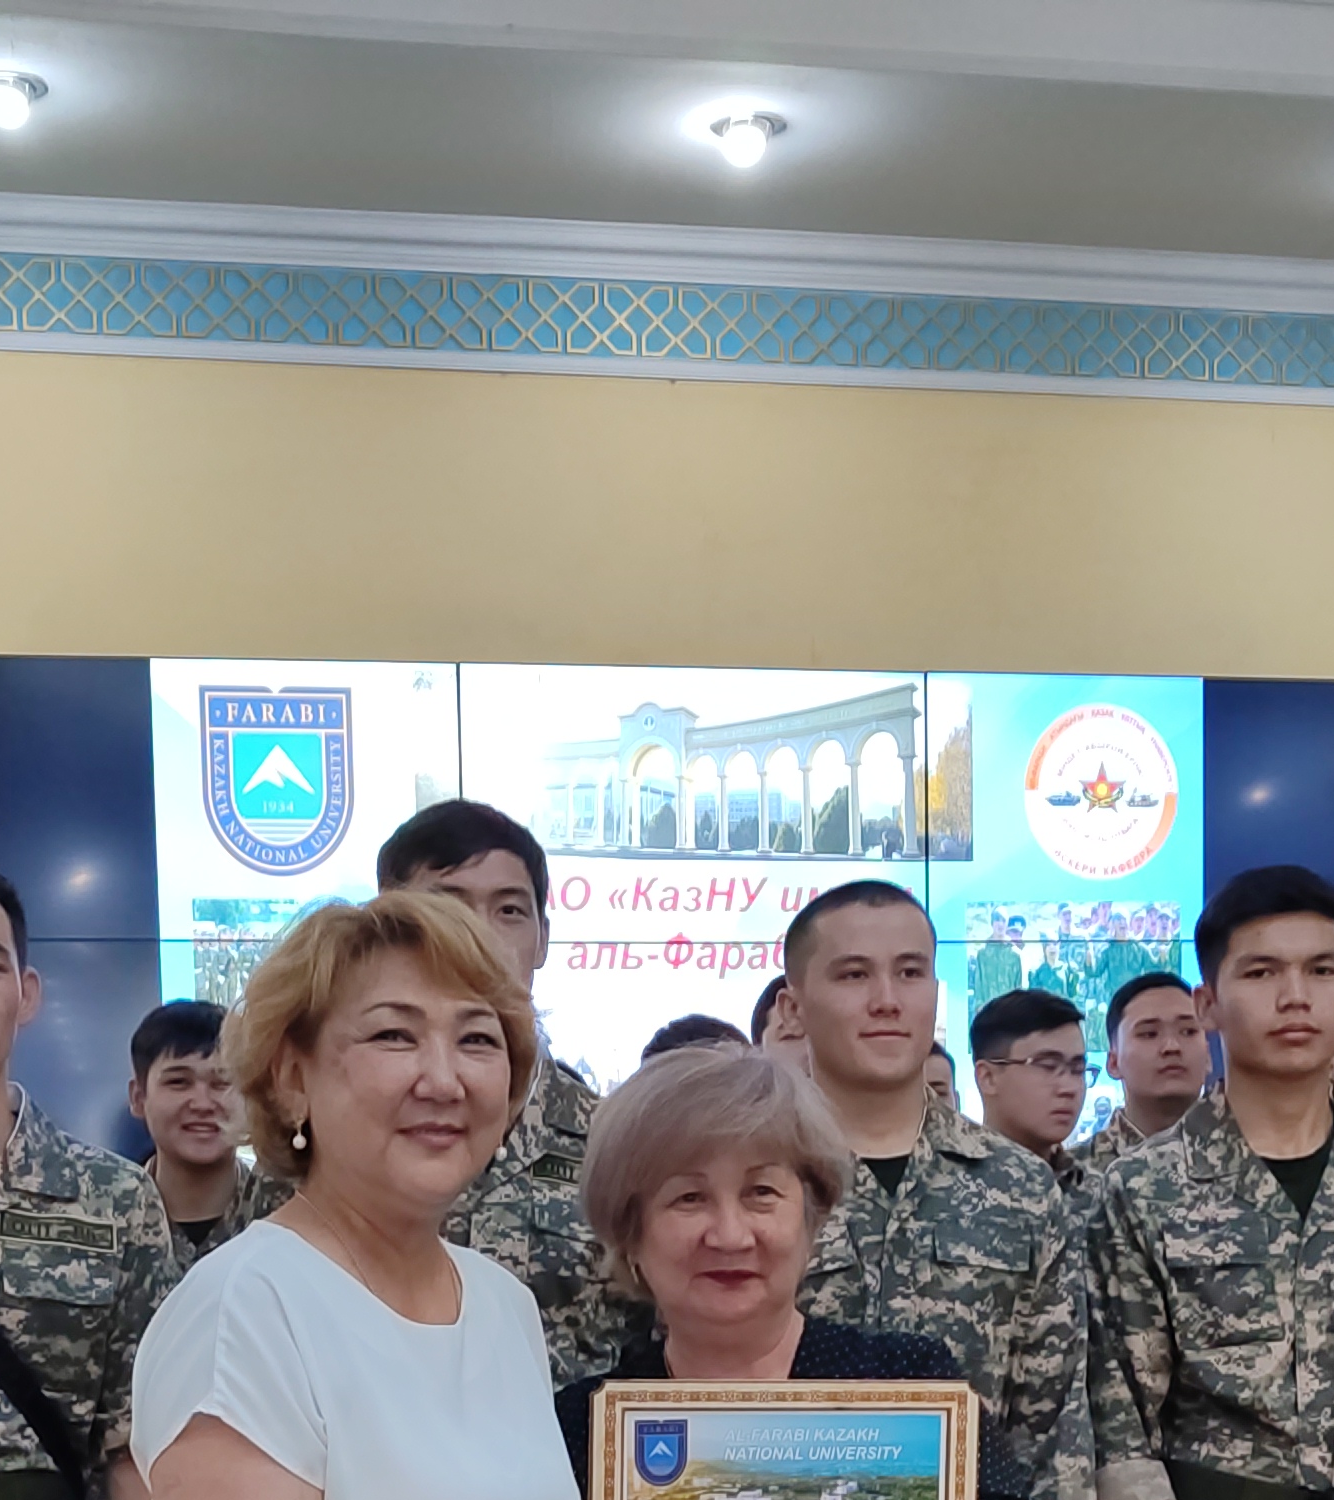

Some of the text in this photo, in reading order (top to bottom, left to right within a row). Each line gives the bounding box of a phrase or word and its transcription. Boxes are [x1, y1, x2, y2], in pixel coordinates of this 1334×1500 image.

[225, 702, 326, 723] FARABI
[213, 739, 342, 864] KAZAKH NATIONAL UNIVERSITY
[608, 875, 769, 912] «КазНУ
[566, 932, 785, 979] аль-Фараб
[724, 1427, 880, 1442] AL-FARABI KAZAKH
[724, 1445, 903, 1461] NATIONAL UNIVERSITY
